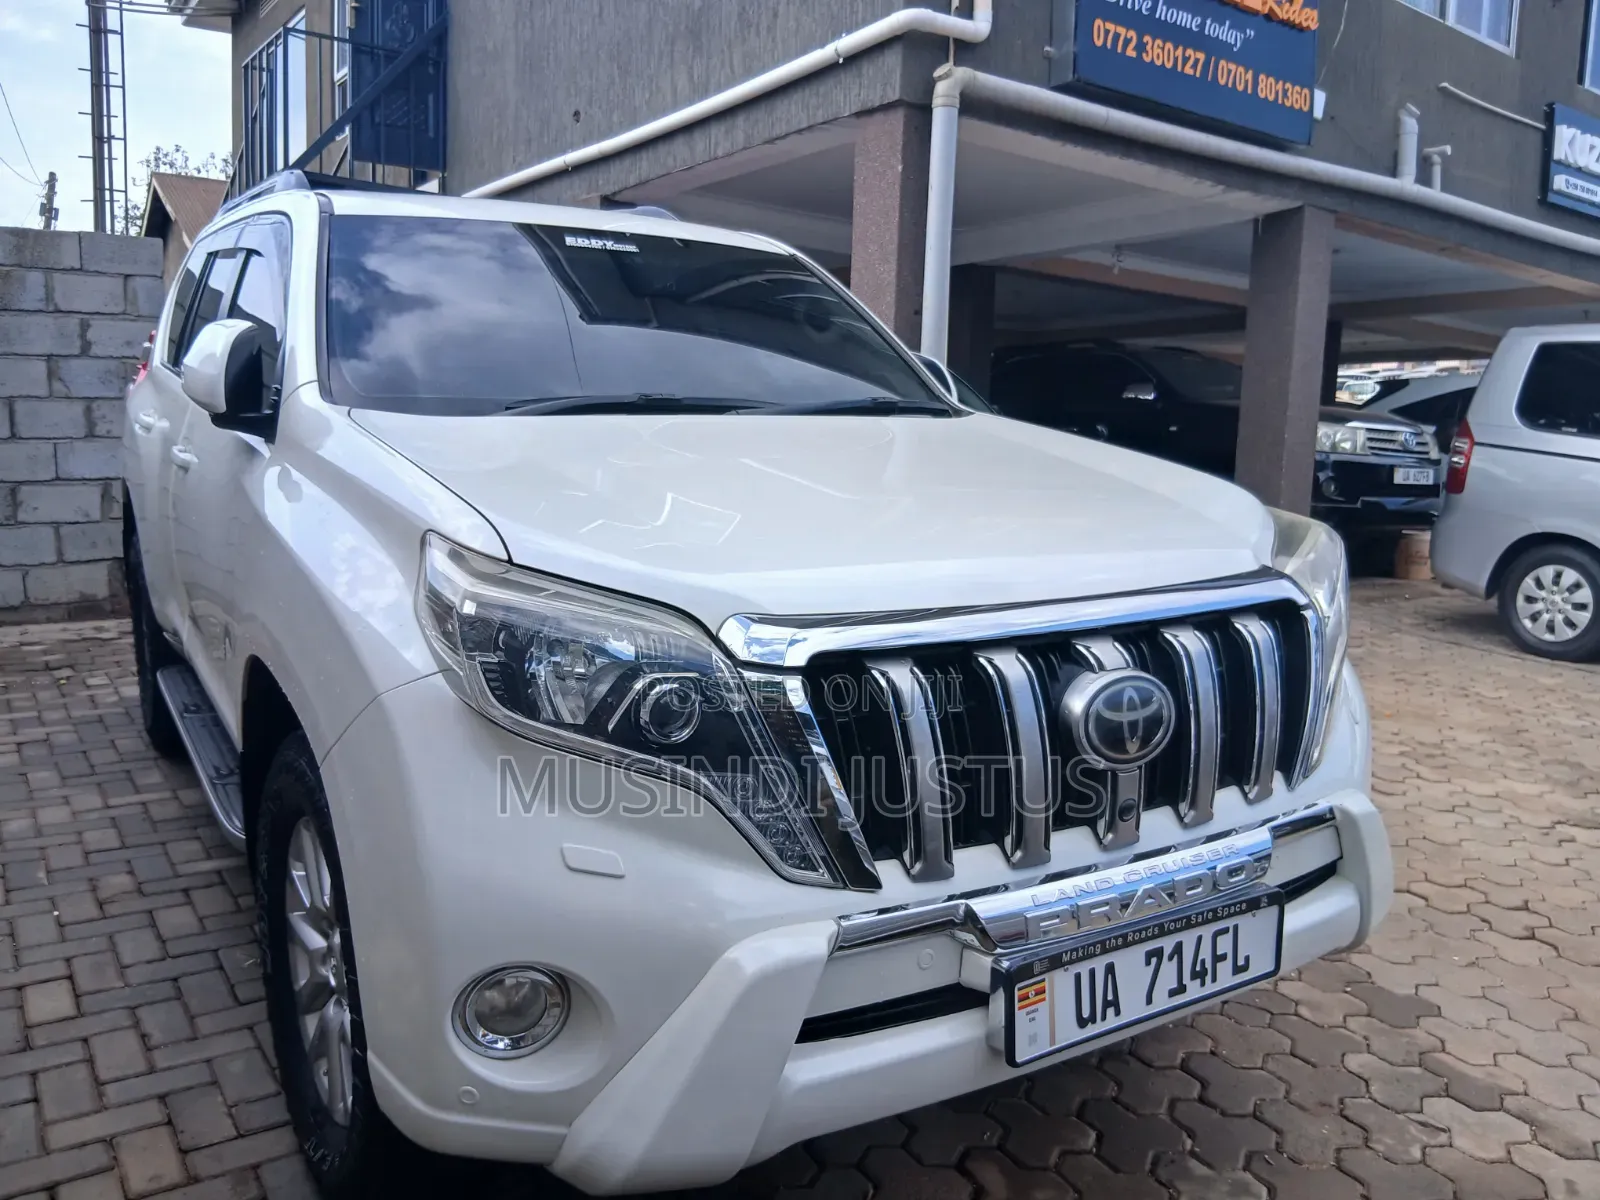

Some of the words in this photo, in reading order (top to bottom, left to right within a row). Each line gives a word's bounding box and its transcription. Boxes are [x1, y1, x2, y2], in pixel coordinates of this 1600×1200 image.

[1105, 0, 1152, 15] ive
[1155, 0, 1201, 32] home
[1093, 18, 1137, 58] 0772
[1142, 35, 1205, 78] 360127
[1208, 56, 1215, 81] /
[1217, 59, 1253, 94] 0701
[1257, 73, 1311, 112] 801360
[565, 236, 614, 247] EDDY
[1023, 856, 1254, 943] PRADO
[1031, 877, 1116, 907] LAND
[1122, 843, 1240, 883] CRUISER
[1061, 943, 1102, 964] Making
[1105, 937, 1123, 949] the
[1127, 926, 1159, 942] Roads
[1163, 917, 1187, 932] Your
[1190, 910, 1213, 924] Safe
[1217, 901, 1247, 917] Space
[1074, 961, 1121, 1029] UA
[1144, 923, 1250, 1007] 714FL
